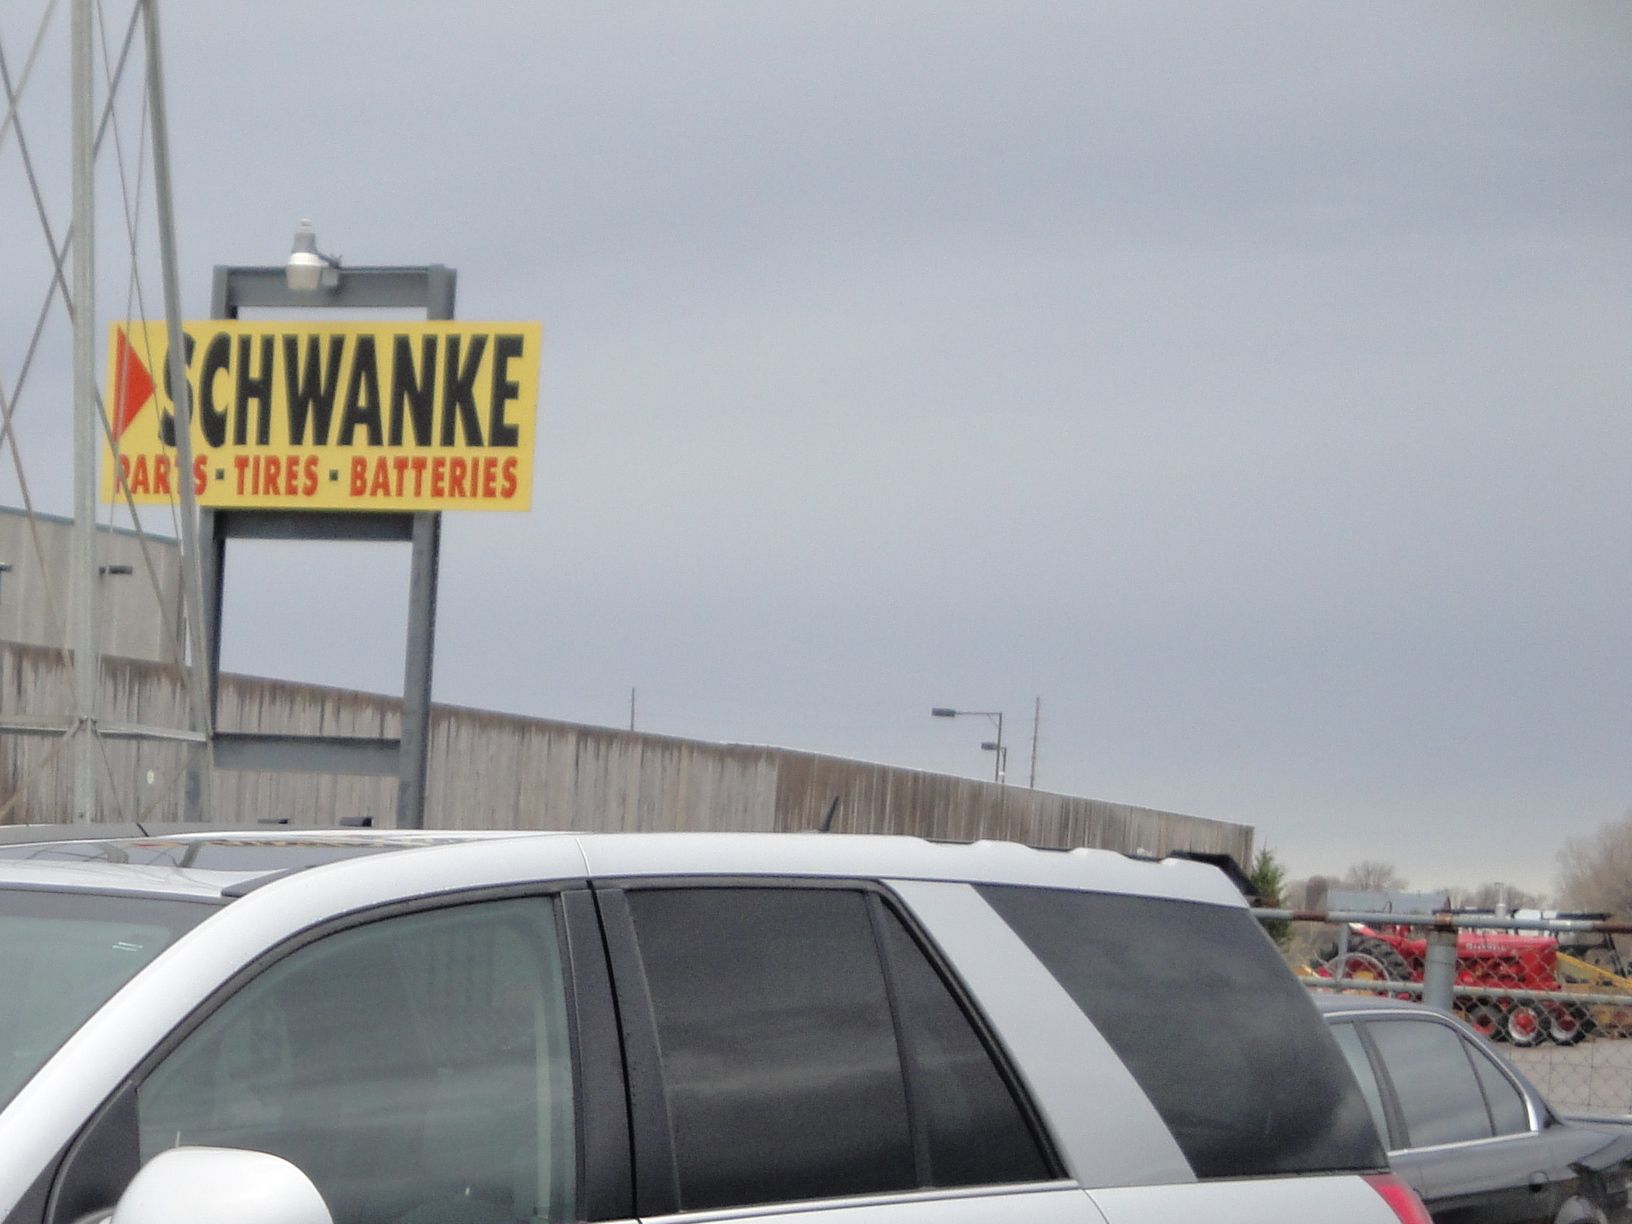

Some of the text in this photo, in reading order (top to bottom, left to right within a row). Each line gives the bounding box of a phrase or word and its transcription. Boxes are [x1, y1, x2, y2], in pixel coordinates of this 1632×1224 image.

[158, 331, 525, 448] SCHWANKE
[114, 453, 519, 500] PARS TIRES BATTERIES
